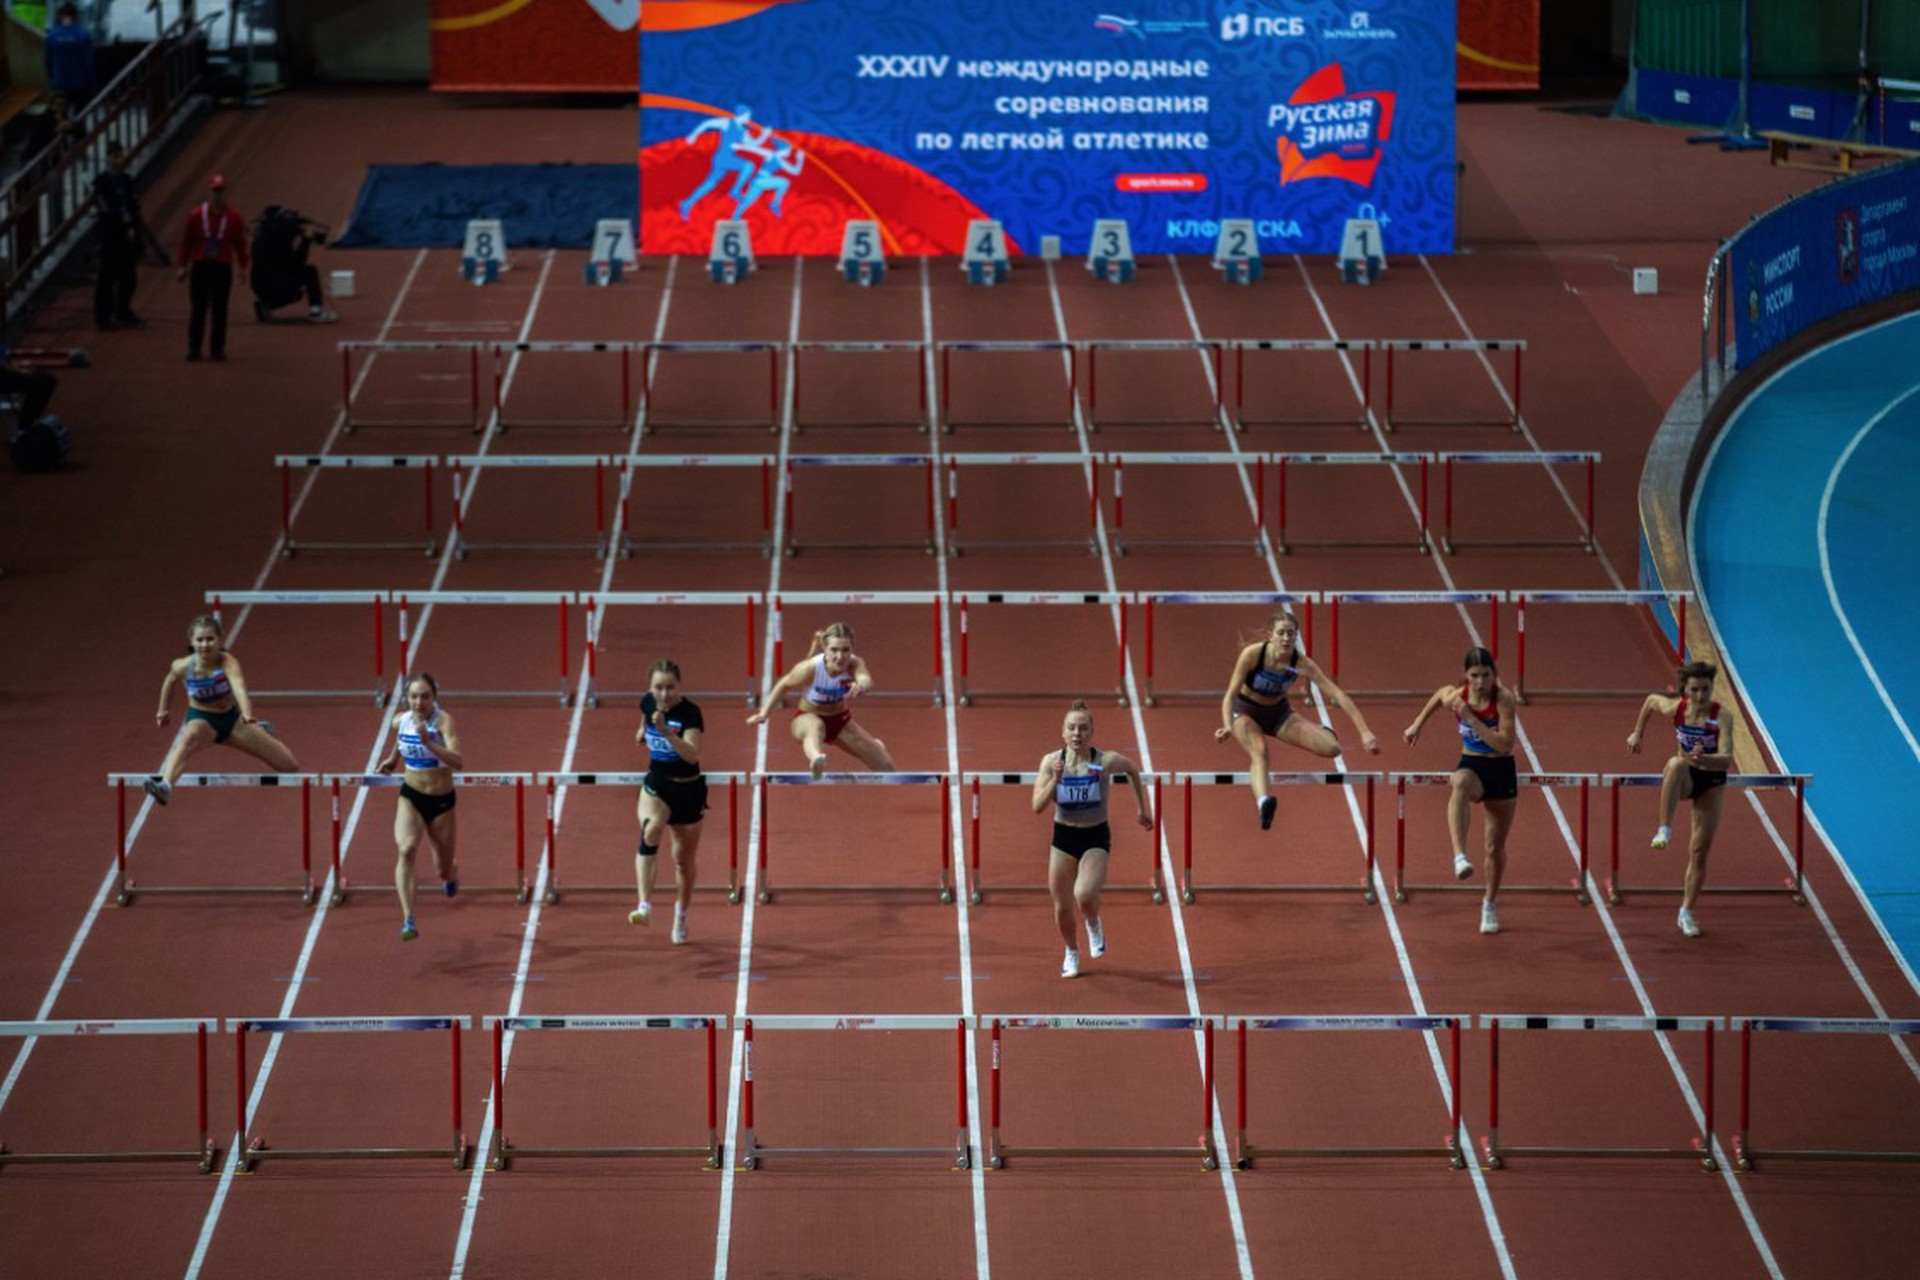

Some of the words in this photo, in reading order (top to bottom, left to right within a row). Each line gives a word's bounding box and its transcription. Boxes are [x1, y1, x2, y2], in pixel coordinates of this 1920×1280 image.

[1255, 17, 1305, 36] ПСБ
[857, 55, 950, 78] XXXIV
[957, 59, 1210, 83] международные
[995, 95, 1210, 119] соревнования
[1267, 99, 1374, 132] Русская
[915, 132, 953, 150] по
[960, 128, 1065, 150] легкой
[1072, 132, 1210, 150] атлетике
[1300, 120, 1370, 149] Зима
[475, 232, 493, 258] 8
[604, 231, 623, 258] 7
[722, 231, 741, 258] 6
[853, 232, 872, 258] 5
[976, 232, 995, 257] 4
[1102, 231, 1120, 257] 3
[1229, 230, 1248, 257] 2
[1354, 230, 1370, 258] 1
[1762, 245, 1801, 285] МИНСПОРТ
[1766, 282, 1794, 317] РОССИИ
[1068, 787, 1089, 801] 178
